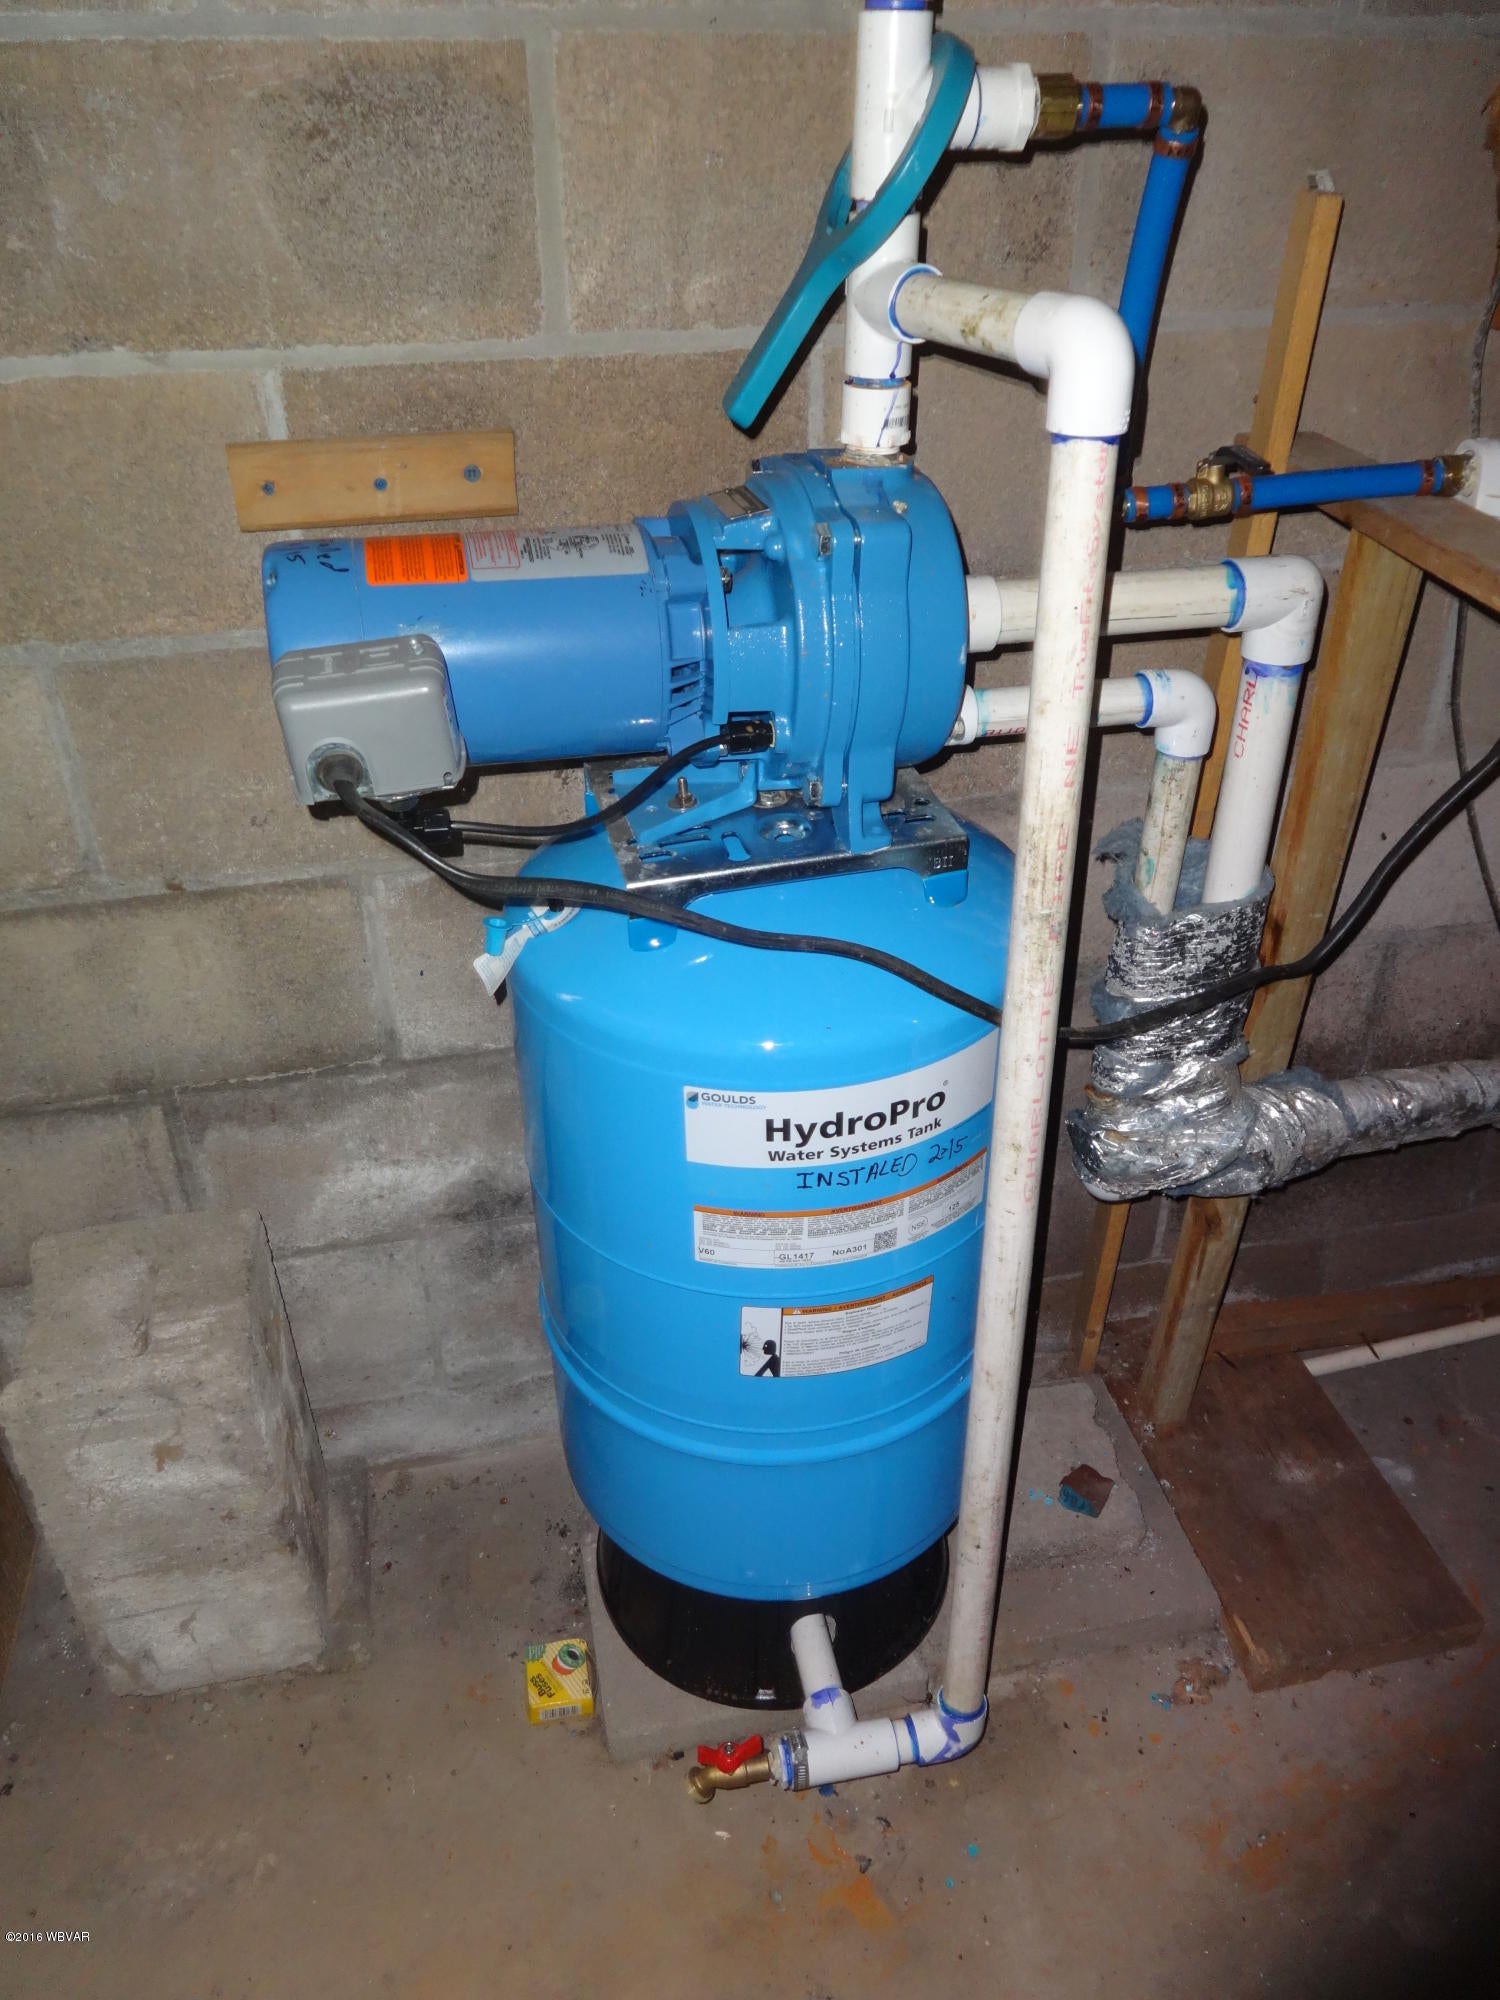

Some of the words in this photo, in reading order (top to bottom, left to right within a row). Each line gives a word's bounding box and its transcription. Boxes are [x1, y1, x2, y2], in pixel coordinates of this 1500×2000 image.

[1234, 674, 1258, 759] CHARL
[701, 1092, 756, 1105] GOULDS
[765, 1090, 946, 1148] HydroPro
[768, 1150, 824, 1162] Water
[830, 1133, 902, 1159] Systems
[908, 1117, 942, 1139] Tank
[796, 1153, 918, 1189] INSTALED
[698, 1247, 715, 1256] V60
[779, 1252, 815, 1261] GL1417
